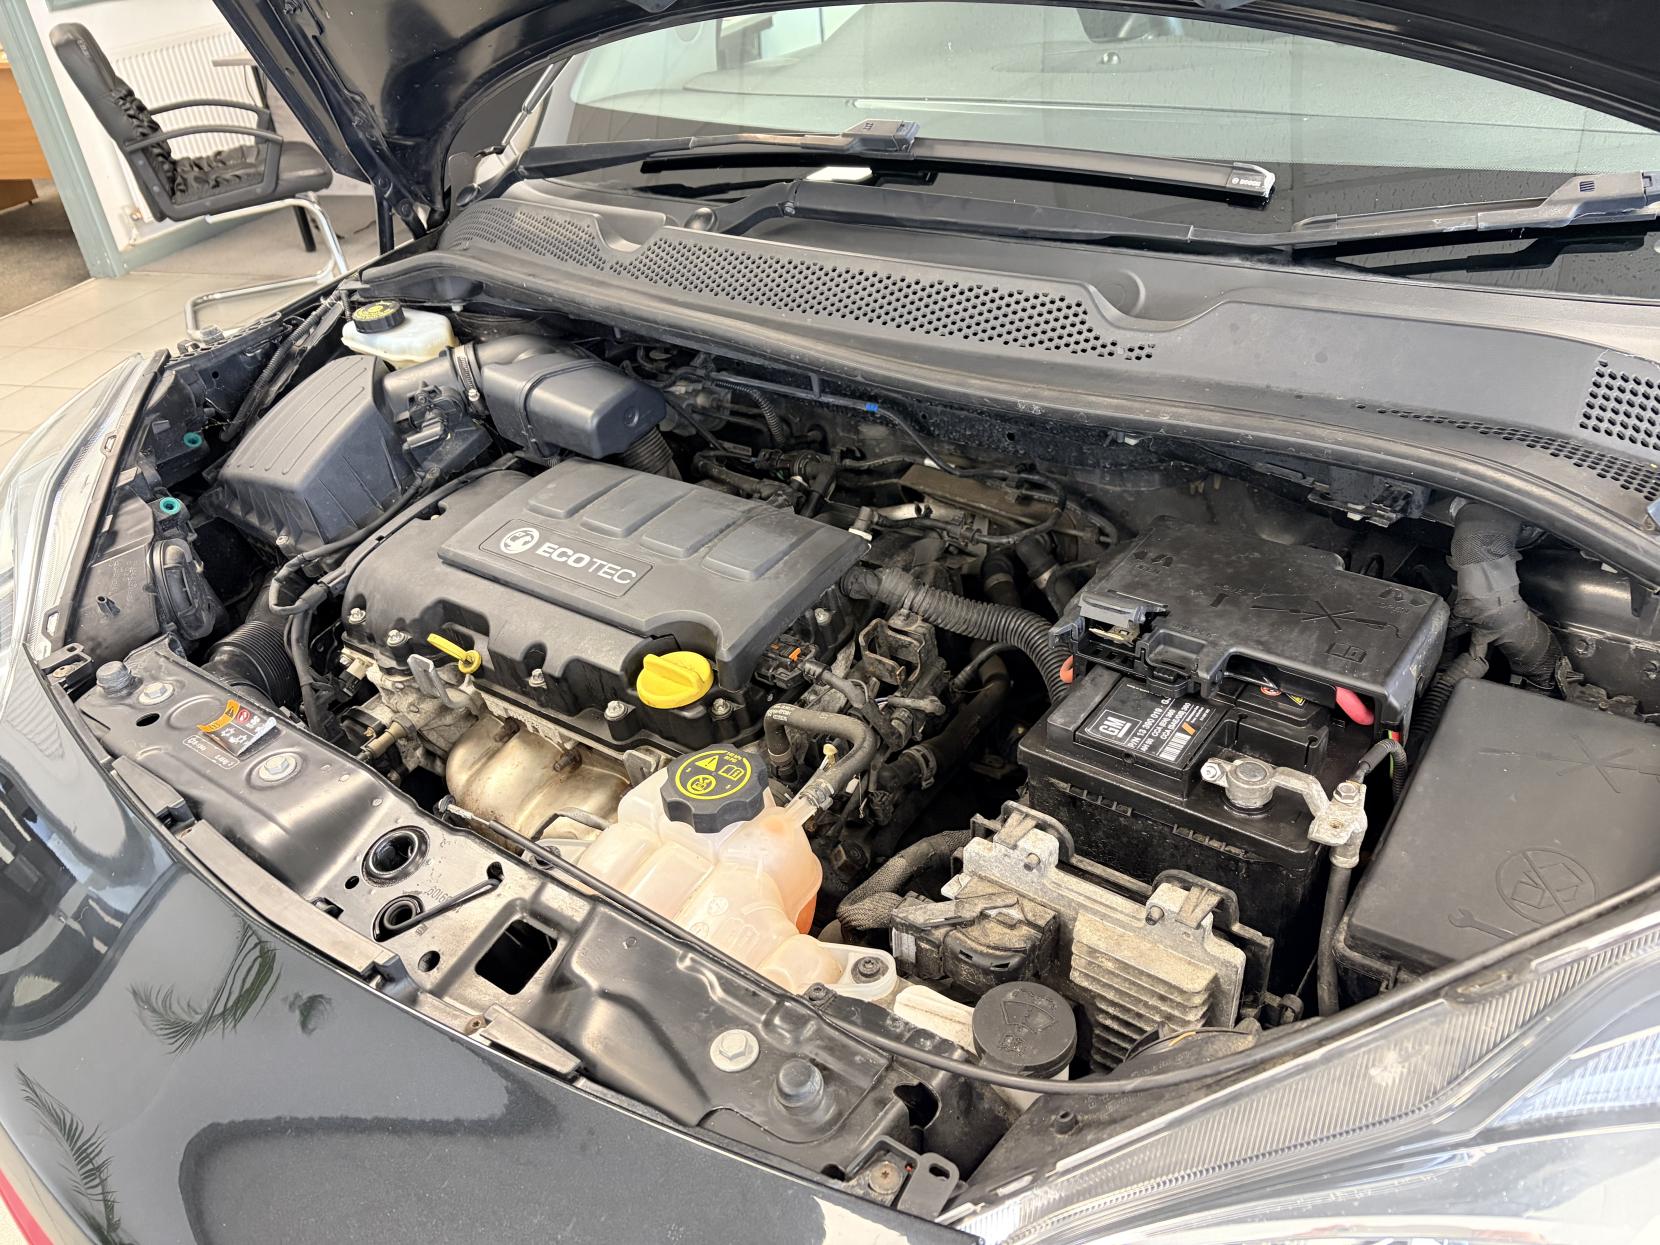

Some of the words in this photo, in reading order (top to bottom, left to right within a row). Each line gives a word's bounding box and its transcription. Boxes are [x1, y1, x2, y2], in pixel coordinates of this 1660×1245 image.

[535, 542, 637, 584] ECOTEC
[1098, 716, 1127, 736] GM
[1127, 736, 1142, 749] P/N
